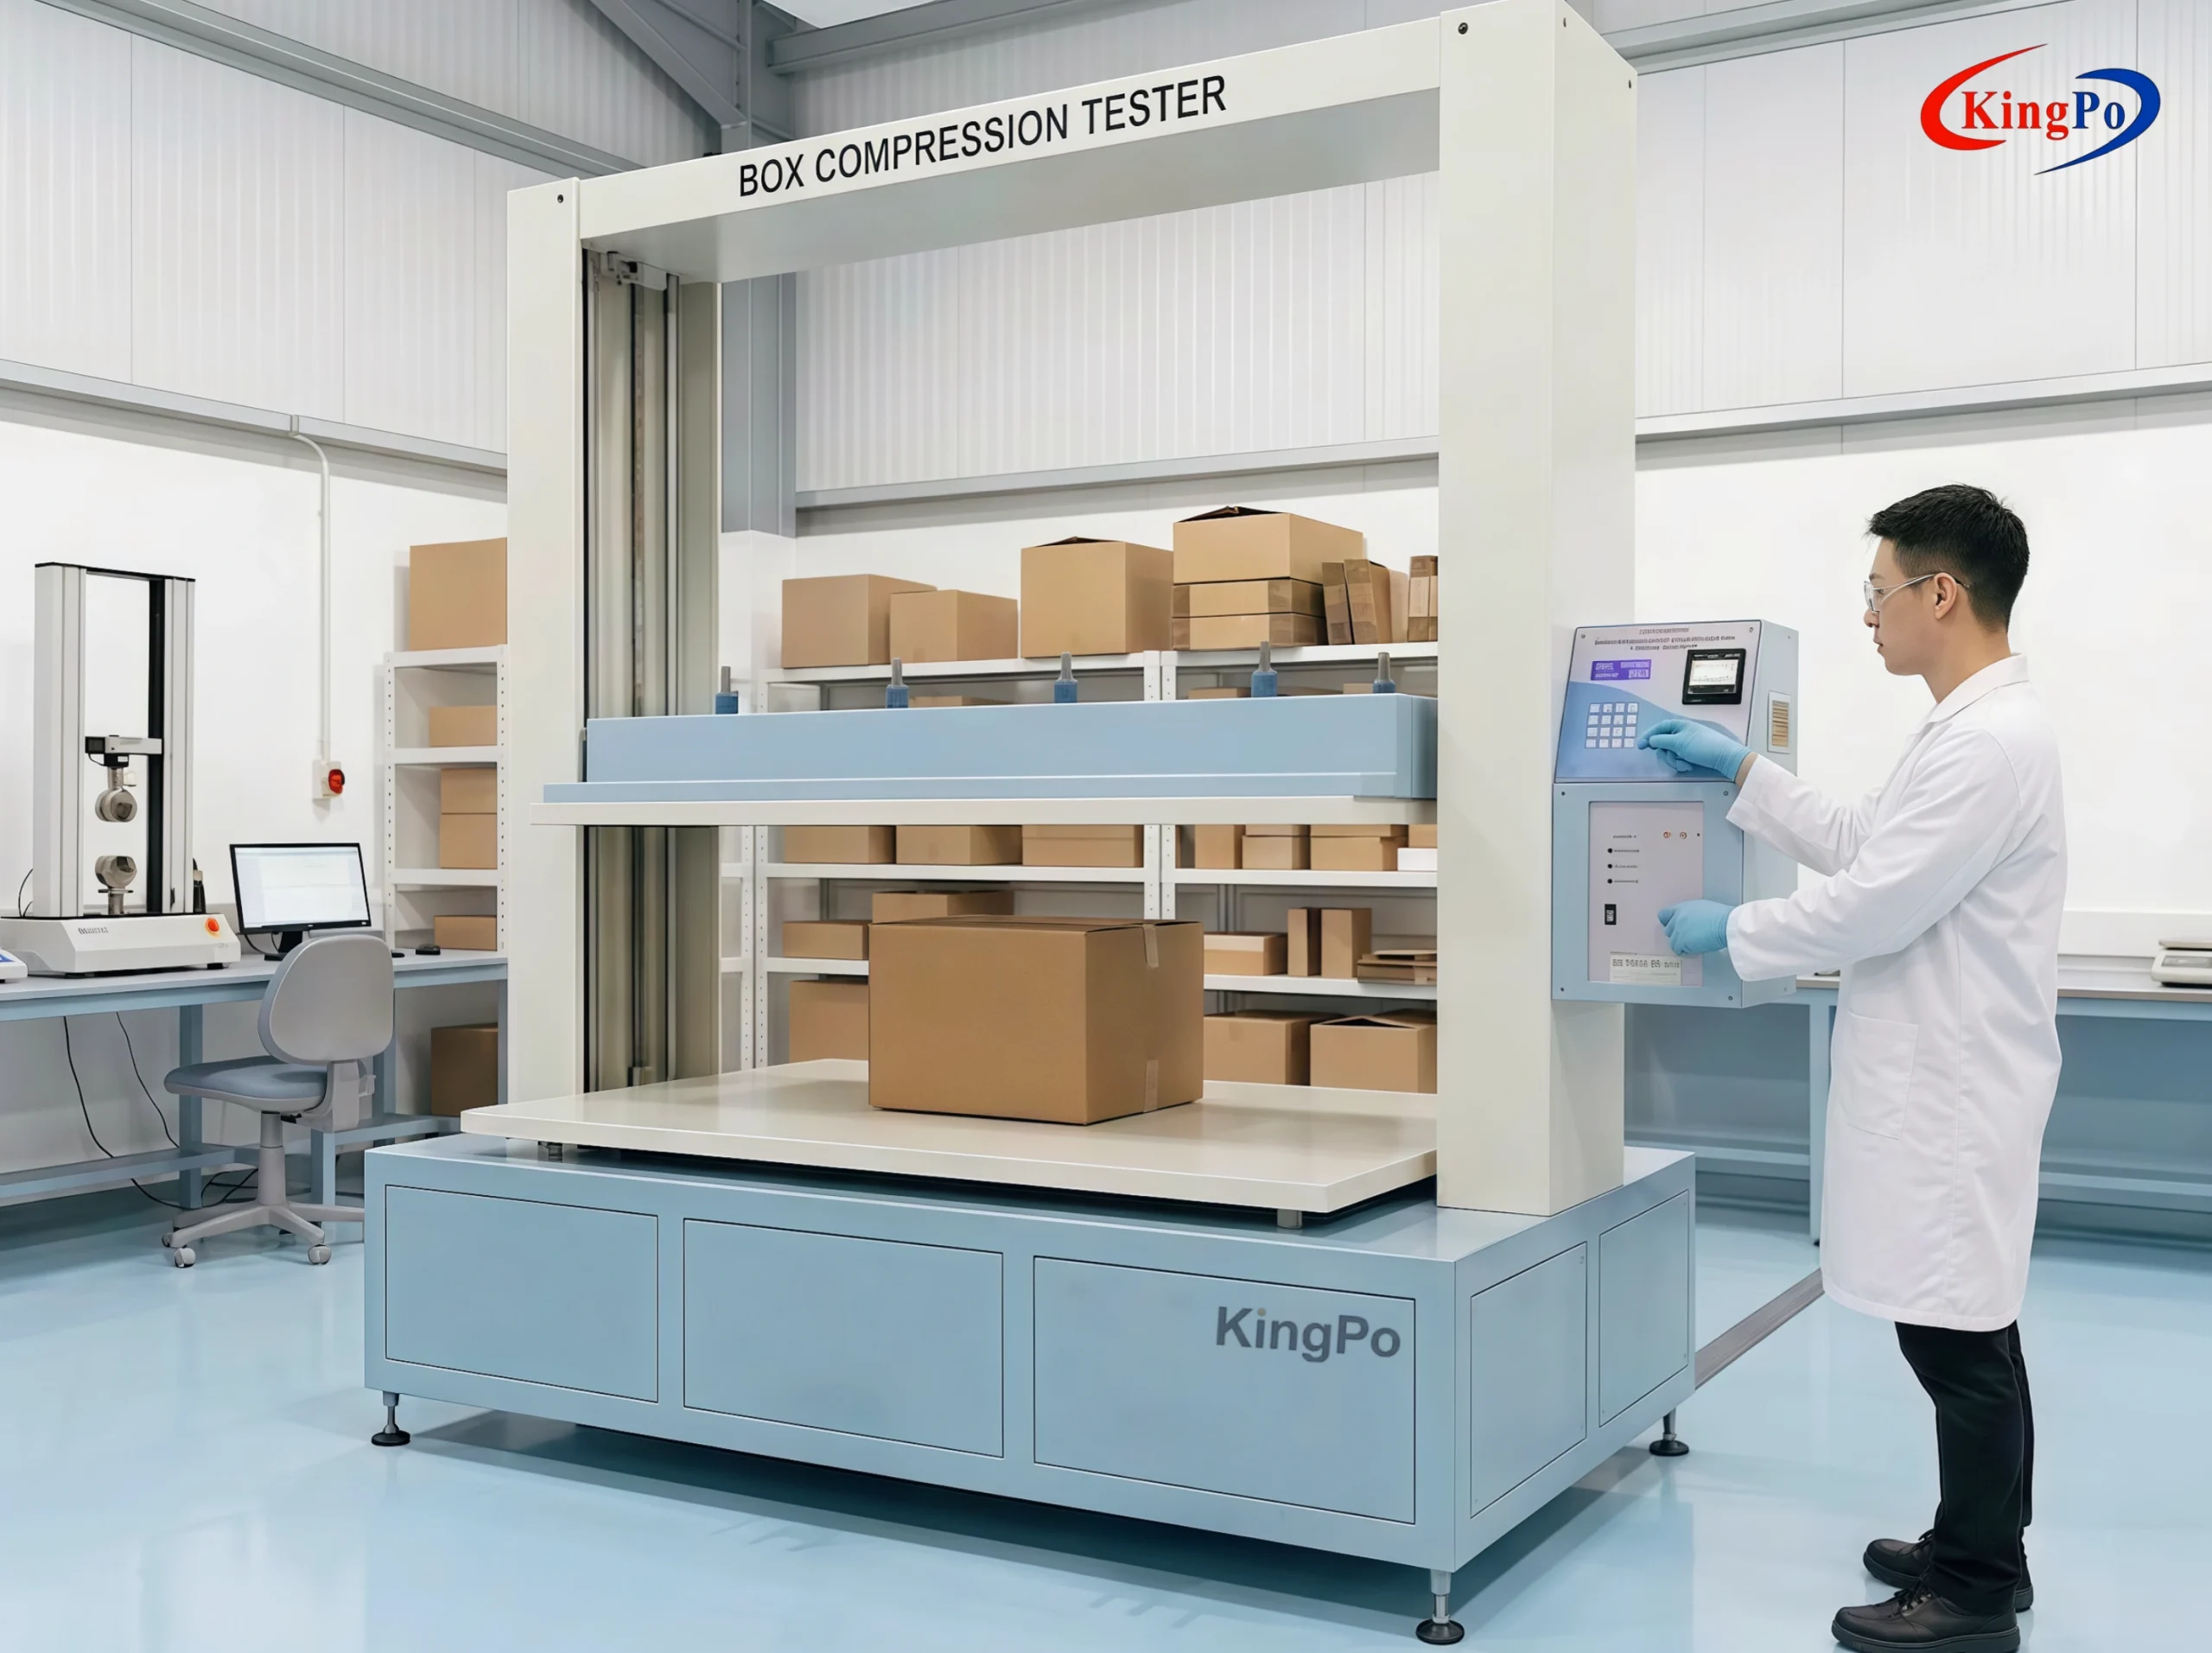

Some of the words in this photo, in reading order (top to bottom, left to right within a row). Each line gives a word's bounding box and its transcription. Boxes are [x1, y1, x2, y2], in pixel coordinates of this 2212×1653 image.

[740, 153, 805, 197] BOX
[815, 104, 1068, 183] COMPRESSION
[1080, 74, 1227, 136] TESTER
[1216, 1306, 1402, 1364] KingPo
